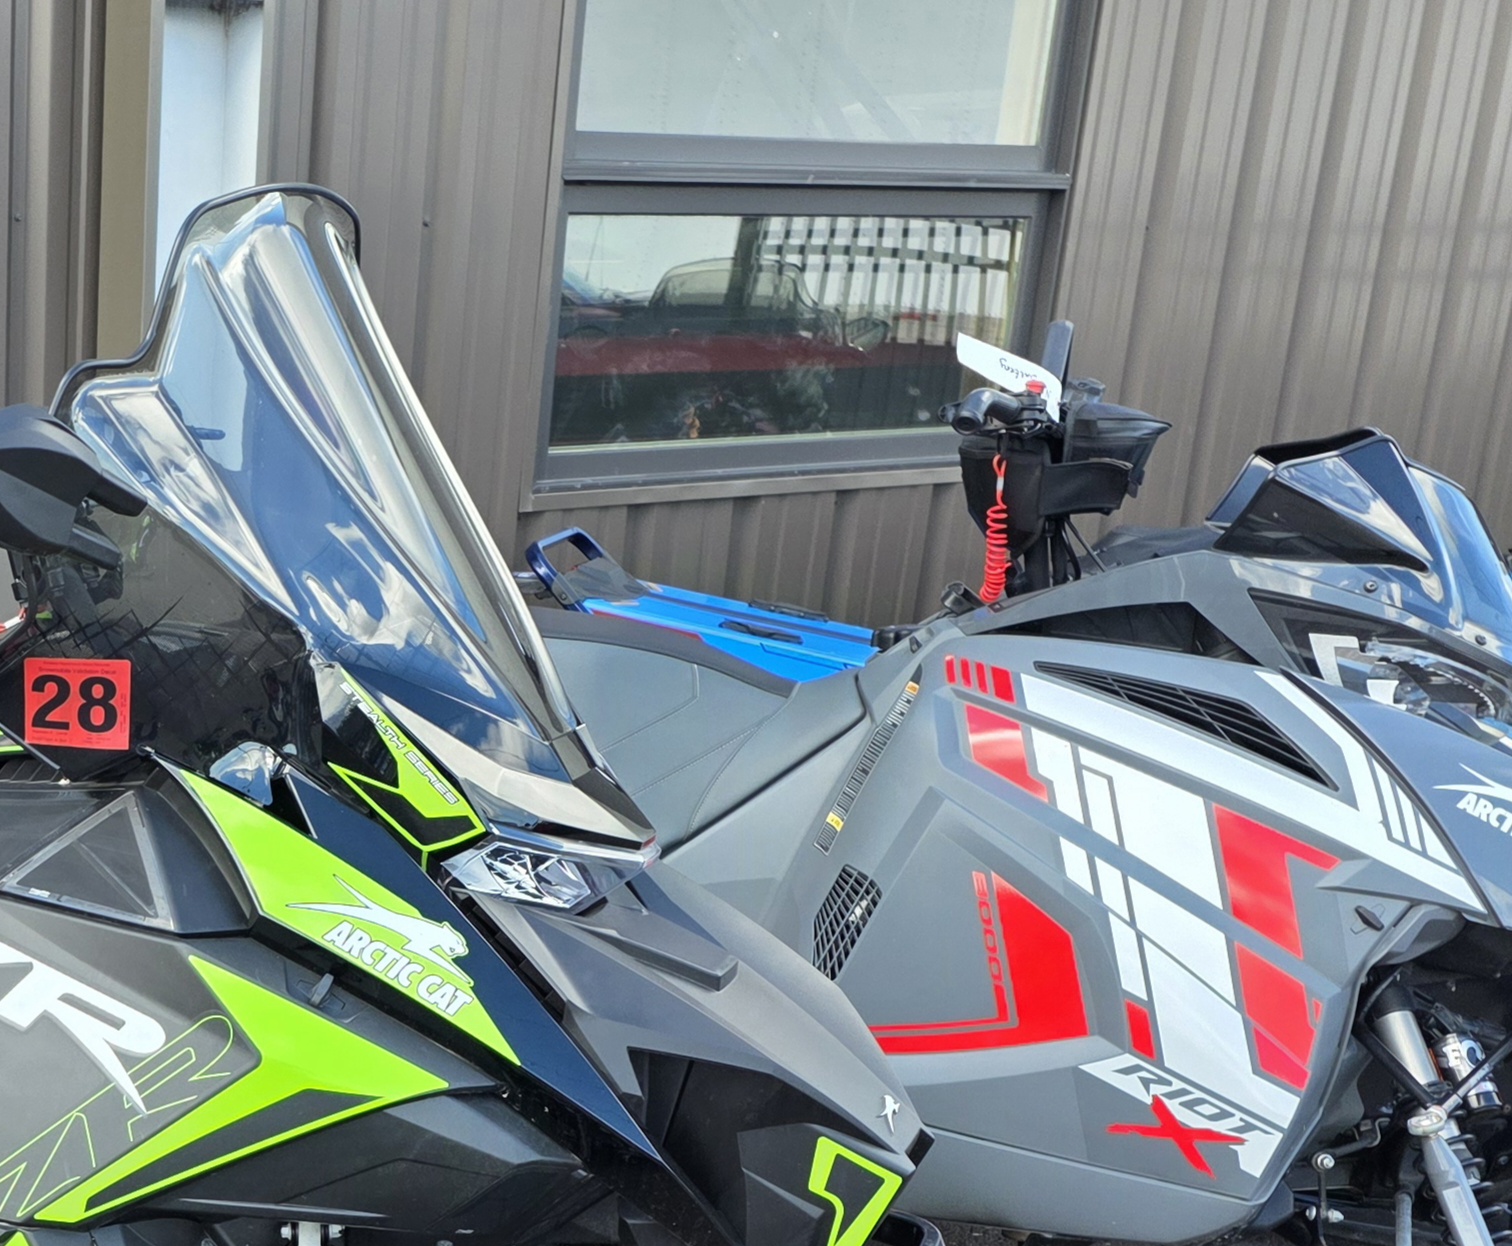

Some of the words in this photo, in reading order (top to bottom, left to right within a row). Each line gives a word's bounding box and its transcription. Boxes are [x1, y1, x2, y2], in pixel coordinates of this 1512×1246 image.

[31, 674, 118, 733] 28
[339, 681, 407, 750] STEALTH
[404, 750, 460, 805] SERIES
[1456, 792, 1512, 836] ARCT
[322, 919, 426, 989] ARCTIC
[417, 974, 475, 1017] CAT
[1105, 1093, 1250, 1181] X
[1112, 1063, 1275, 1136] RIOT
